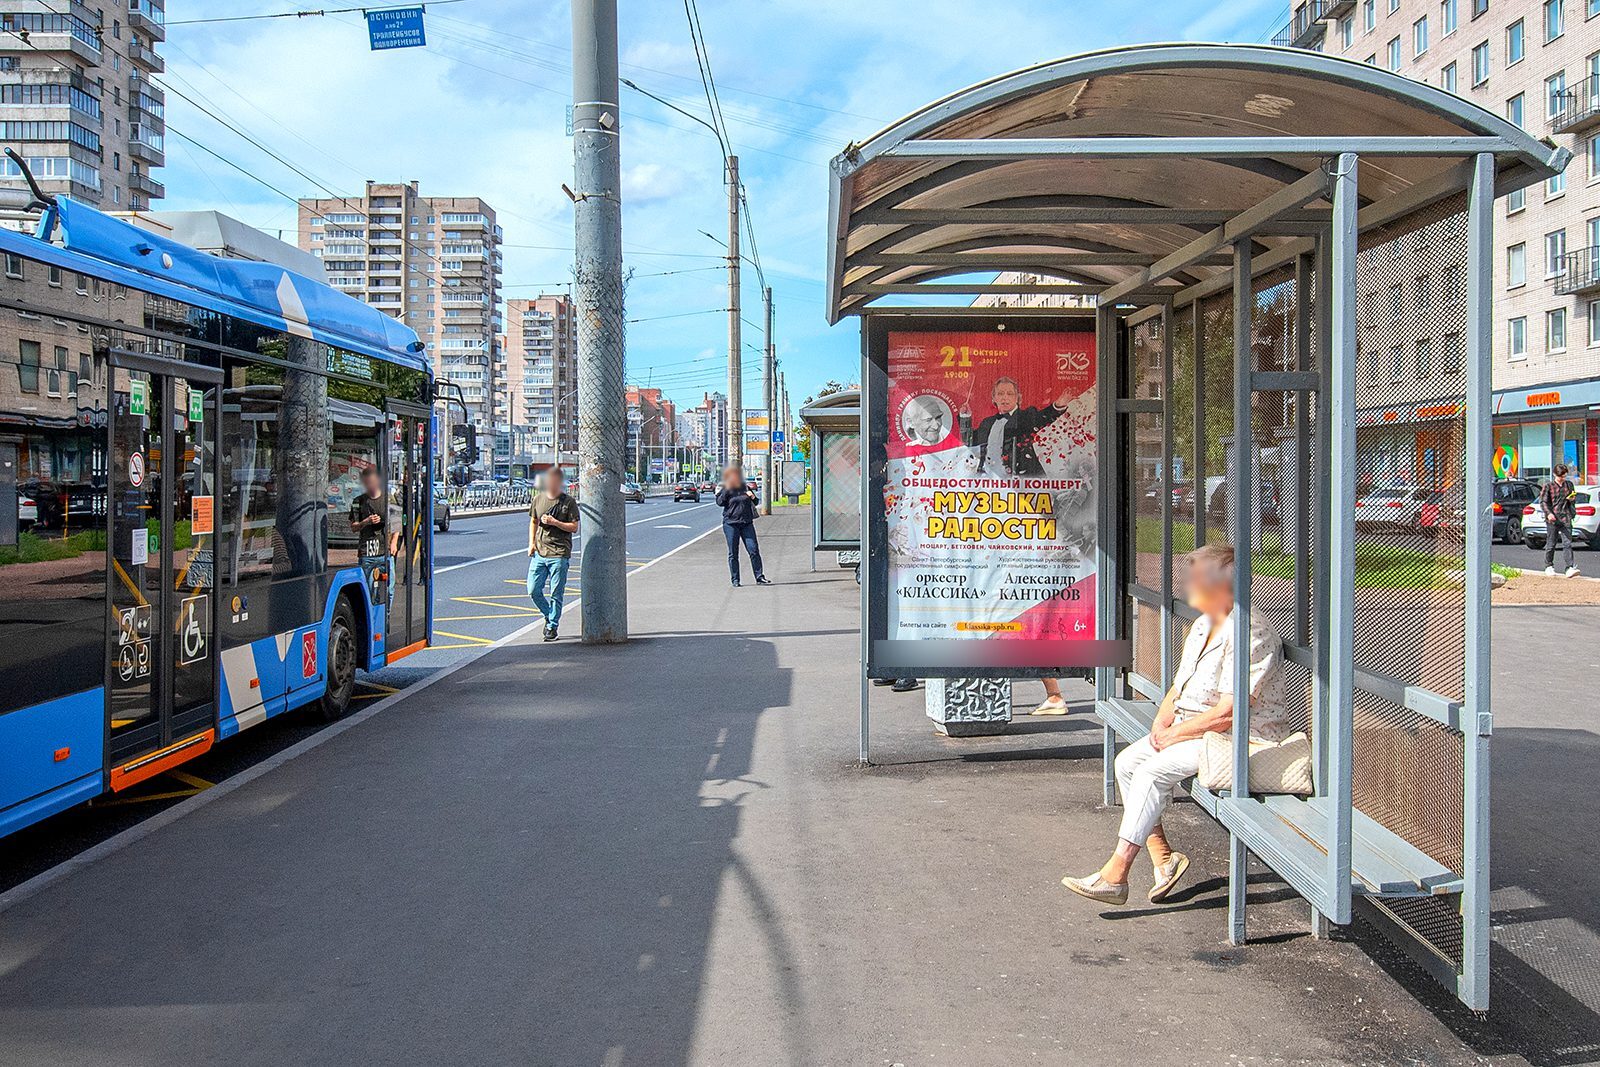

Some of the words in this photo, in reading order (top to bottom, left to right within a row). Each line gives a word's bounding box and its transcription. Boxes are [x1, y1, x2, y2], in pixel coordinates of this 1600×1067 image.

[370, 11, 418, 21] ОСТАНОВКА
[373, 30, 420, 40] ТРОЛЛЕЙБУСОВ
[940, 345, 972, 367] 21
[921, 388, 958, 413] ПОСВЯЩАЕТСЯ
[901, 477, 1020, 489] ОБЩЕДОСТУПНЫЙ
[1024, 479, 1082, 490] КОНЦЕРТ
[933, 491, 1054, 515] МУЗЫКА
[927, 516, 1057, 542] РАДОСТИ
[916, 573, 967, 584] оркестр
[1004, 572, 1076, 587] Александр
[896, 586, 986, 600] «КЛАССИКА»
[1000, 588, 1081, 601] КАНТОРОВ
[900, 621, 922, 629] Билеты
[931, 621, 947, 629] сайте
[1074, 620, 1087, 632] 6+
